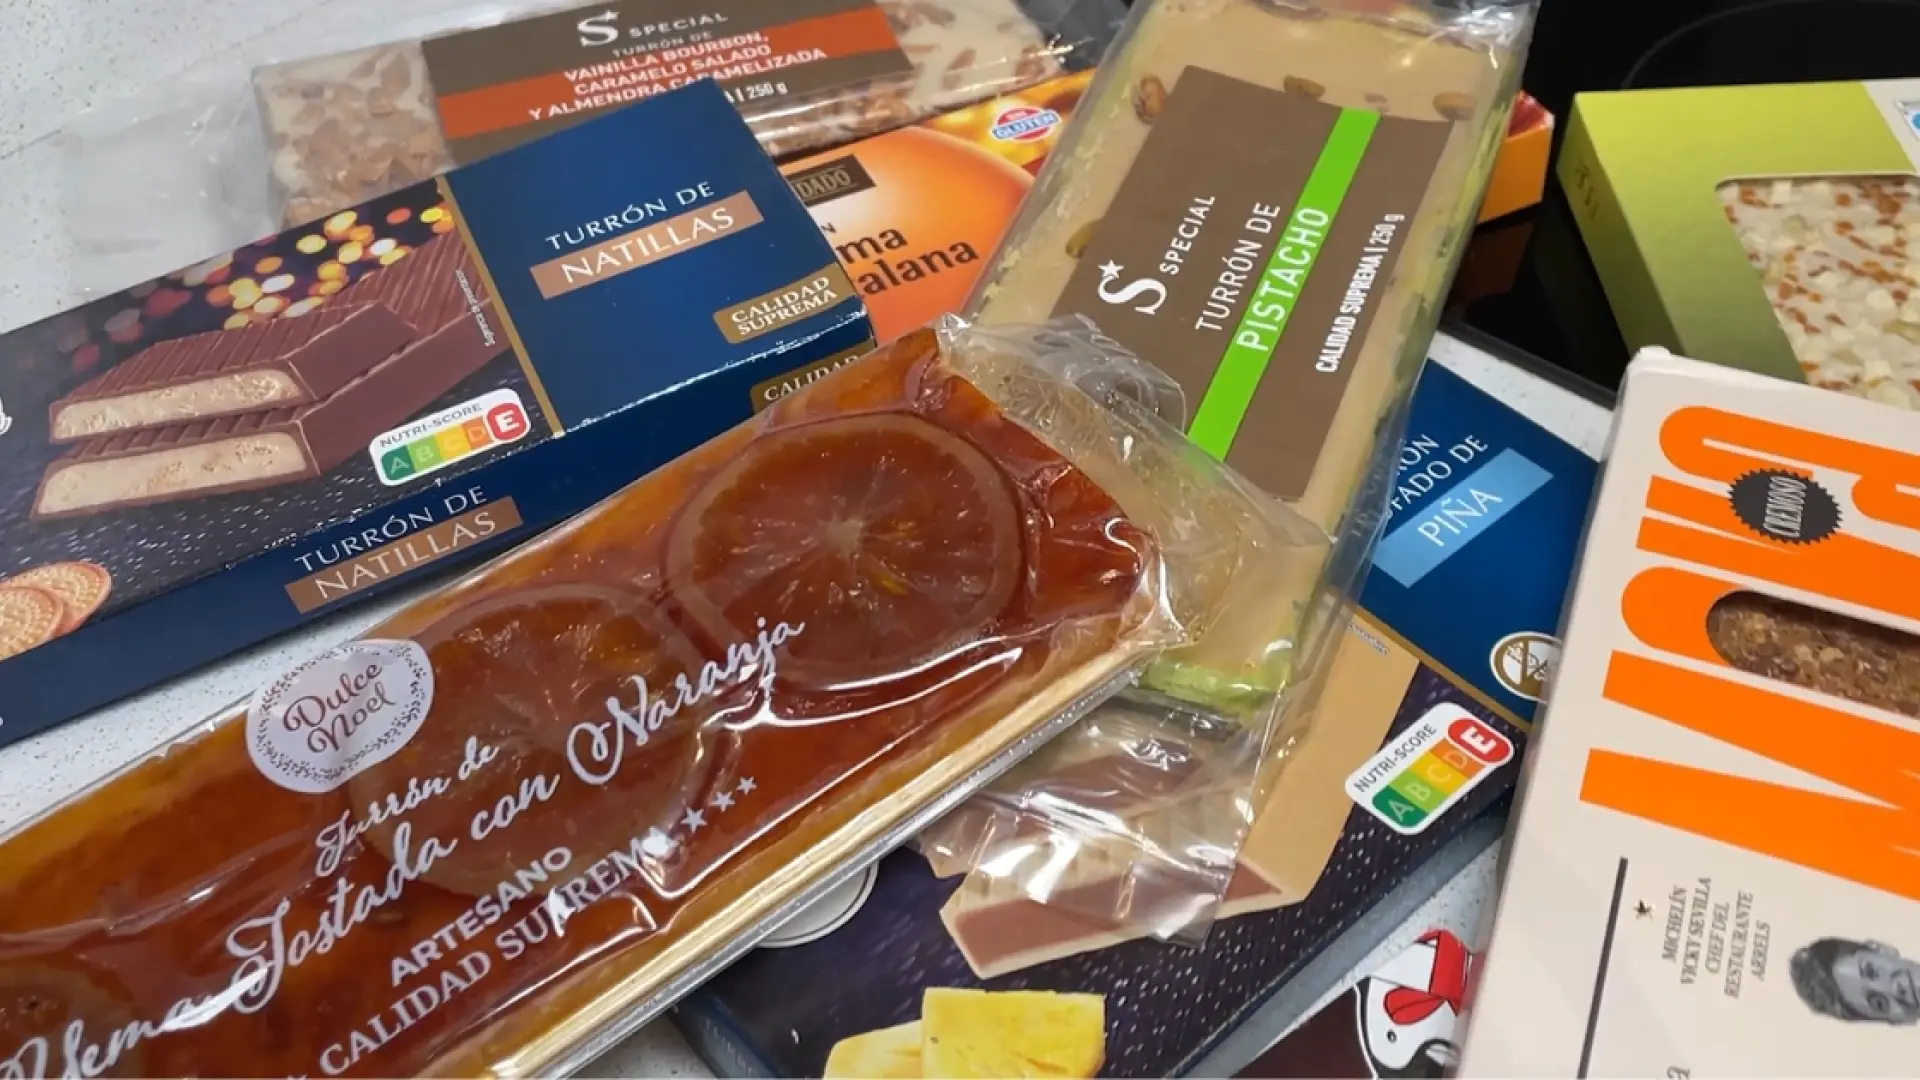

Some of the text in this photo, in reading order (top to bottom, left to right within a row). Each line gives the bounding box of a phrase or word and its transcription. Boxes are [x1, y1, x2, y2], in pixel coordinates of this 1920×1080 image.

[612, 31, 711, 57] TURRÓN DE
[628, 12, 728, 39] SPECIAL
[529, 107, 542, 121] Y
[548, 82, 667, 118] ALMENDRA
[564, 53, 659, 82] VAINILLA
[574, 44, 772, 96] CARAMELO SALADO
[747, 82, 774, 99] 250
[776, 82, 788, 96] g
[546, 181, 715, 250] TURRÓN DE
[561, 208, 735, 283] NATILLAS
[835, 228, 908, 264] ma
[1159, 195, 1216, 276] SPECIAL
[731, 276, 831, 323] CALIDAD
[857, 240, 979, 296] alana
[1195, 202, 1281, 332] TURRÓN DE
[1235, 207, 1329, 351] PISTACHO
[1315, 213, 1405, 373] CALIDAD SUPREMA 250 g
[739, 288, 838, 335] SUPREMA
[380, 403, 482, 448] NUTRI-SCORE
[1449, 434, 1489, 464] DE
[295, 484, 488, 571] TURRÓN DE
[1417, 488, 1503, 547] PIÑA
[314, 512, 496, 599] NATILLAS
[282, 660, 384, 733] Dulce
[306, 684, 396, 755] Noel
[1353, 723, 1437, 793] NUTRI-SCORE
[226, 822, 458, 1015] Tostada
[471, 770, 562, 841] con
[566, 616, 806, 786] Naranja
[315, 735, 499, 876] Turrón de
[390, 846, 572, 987] ARTESANO
[1680, 877, 1712, 985] VICKY SEVILLA
[1705, 902, 1730, 974] CHEF DEL
[1723, 890, 1754, 999] RESTAURANTE
[1750, 921, 1771, 981] ARRELS
[320, 950, 492, 1076] CALIDAD
